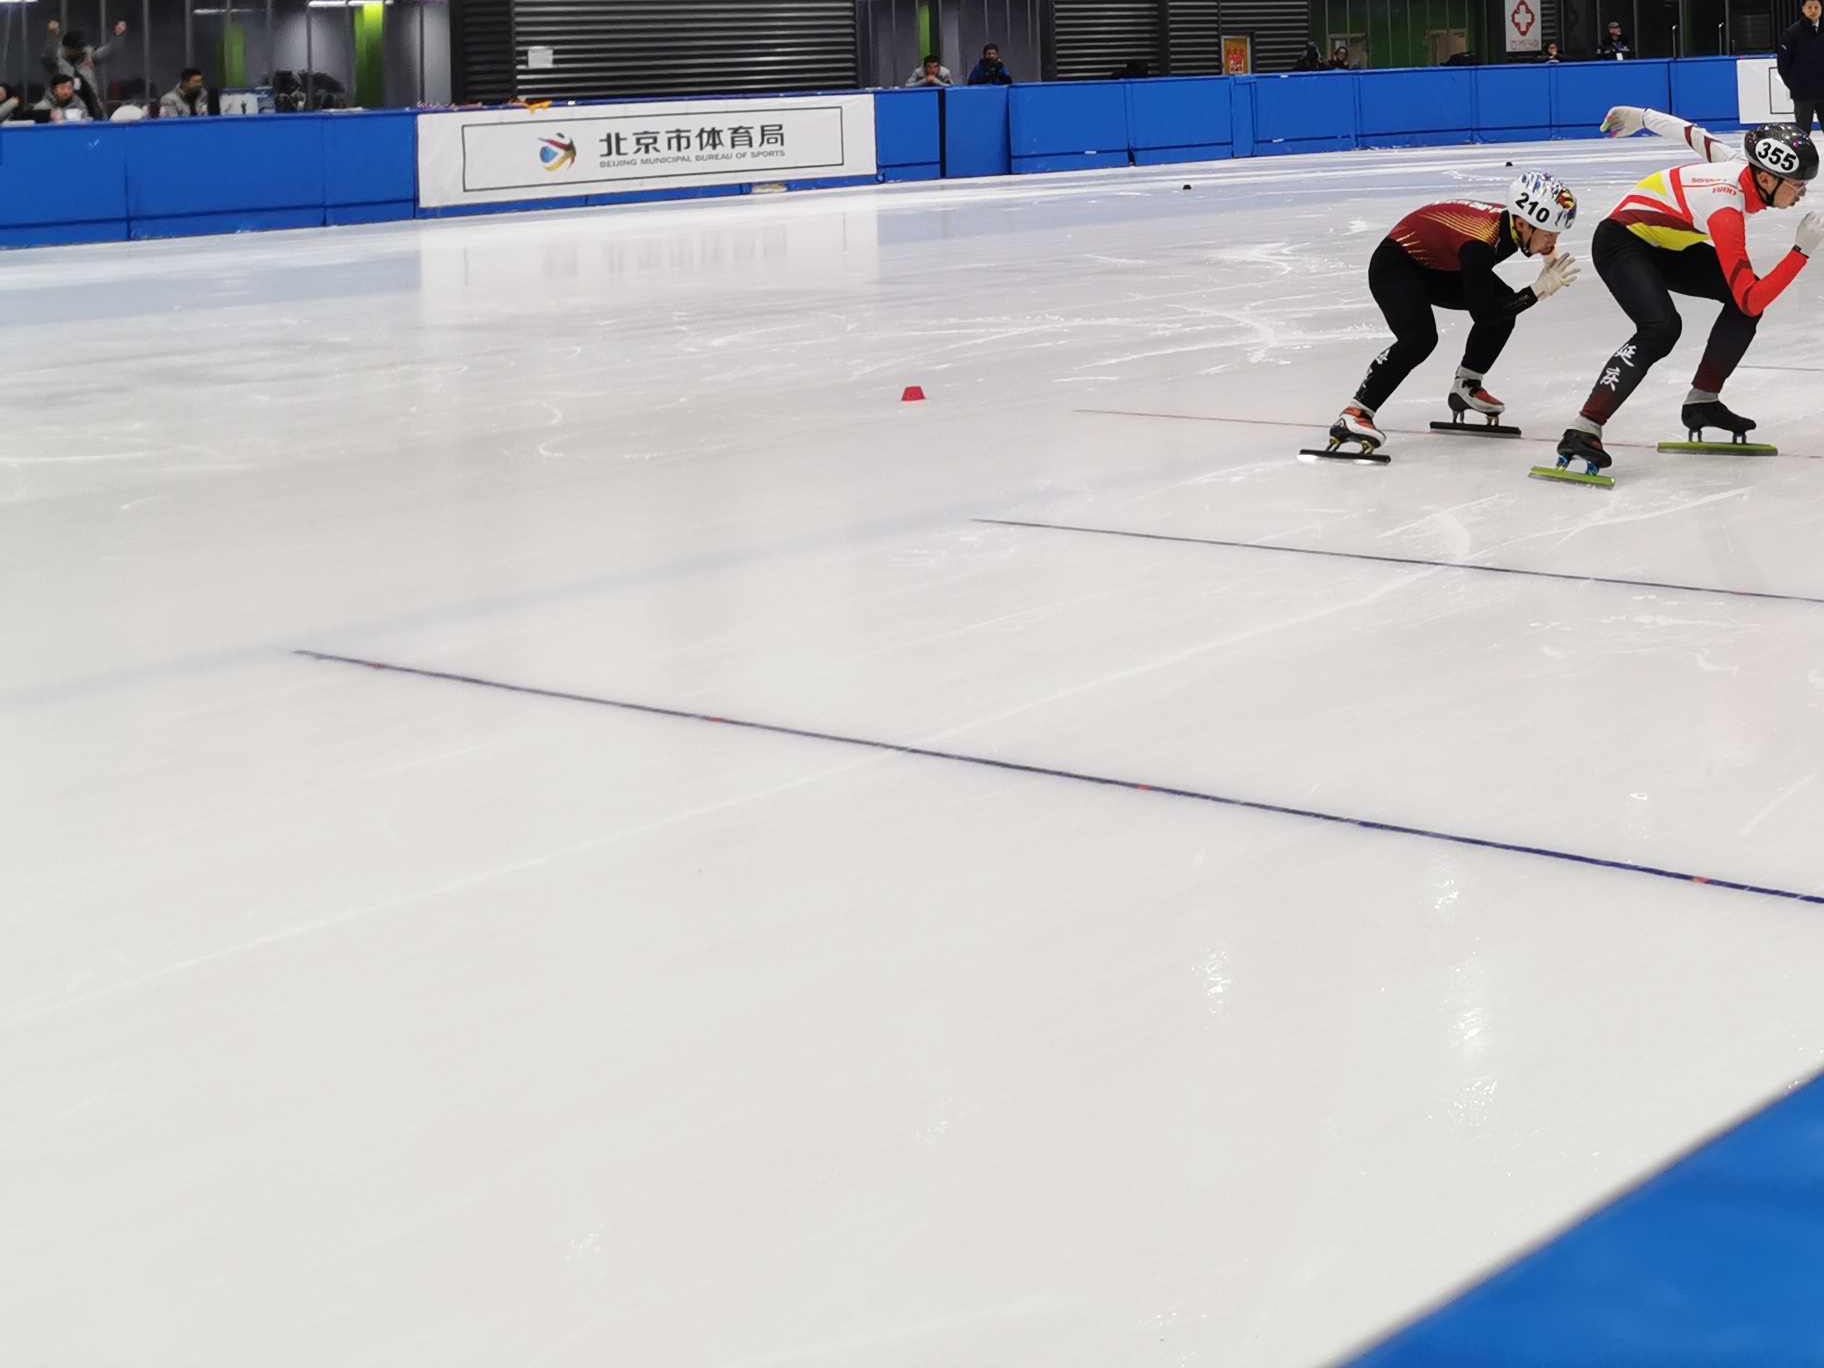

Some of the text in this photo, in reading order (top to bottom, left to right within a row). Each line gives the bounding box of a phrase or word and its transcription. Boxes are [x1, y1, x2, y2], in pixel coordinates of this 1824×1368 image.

[599, 124, 785, 157] 北京市体育局
[600, 150, 785, 168] BEIJING MUNICIPAL BUREAU OF SPORTS
[1757, 142, 1796, 172] 355
[1515, 192, 1550, 223] 210
